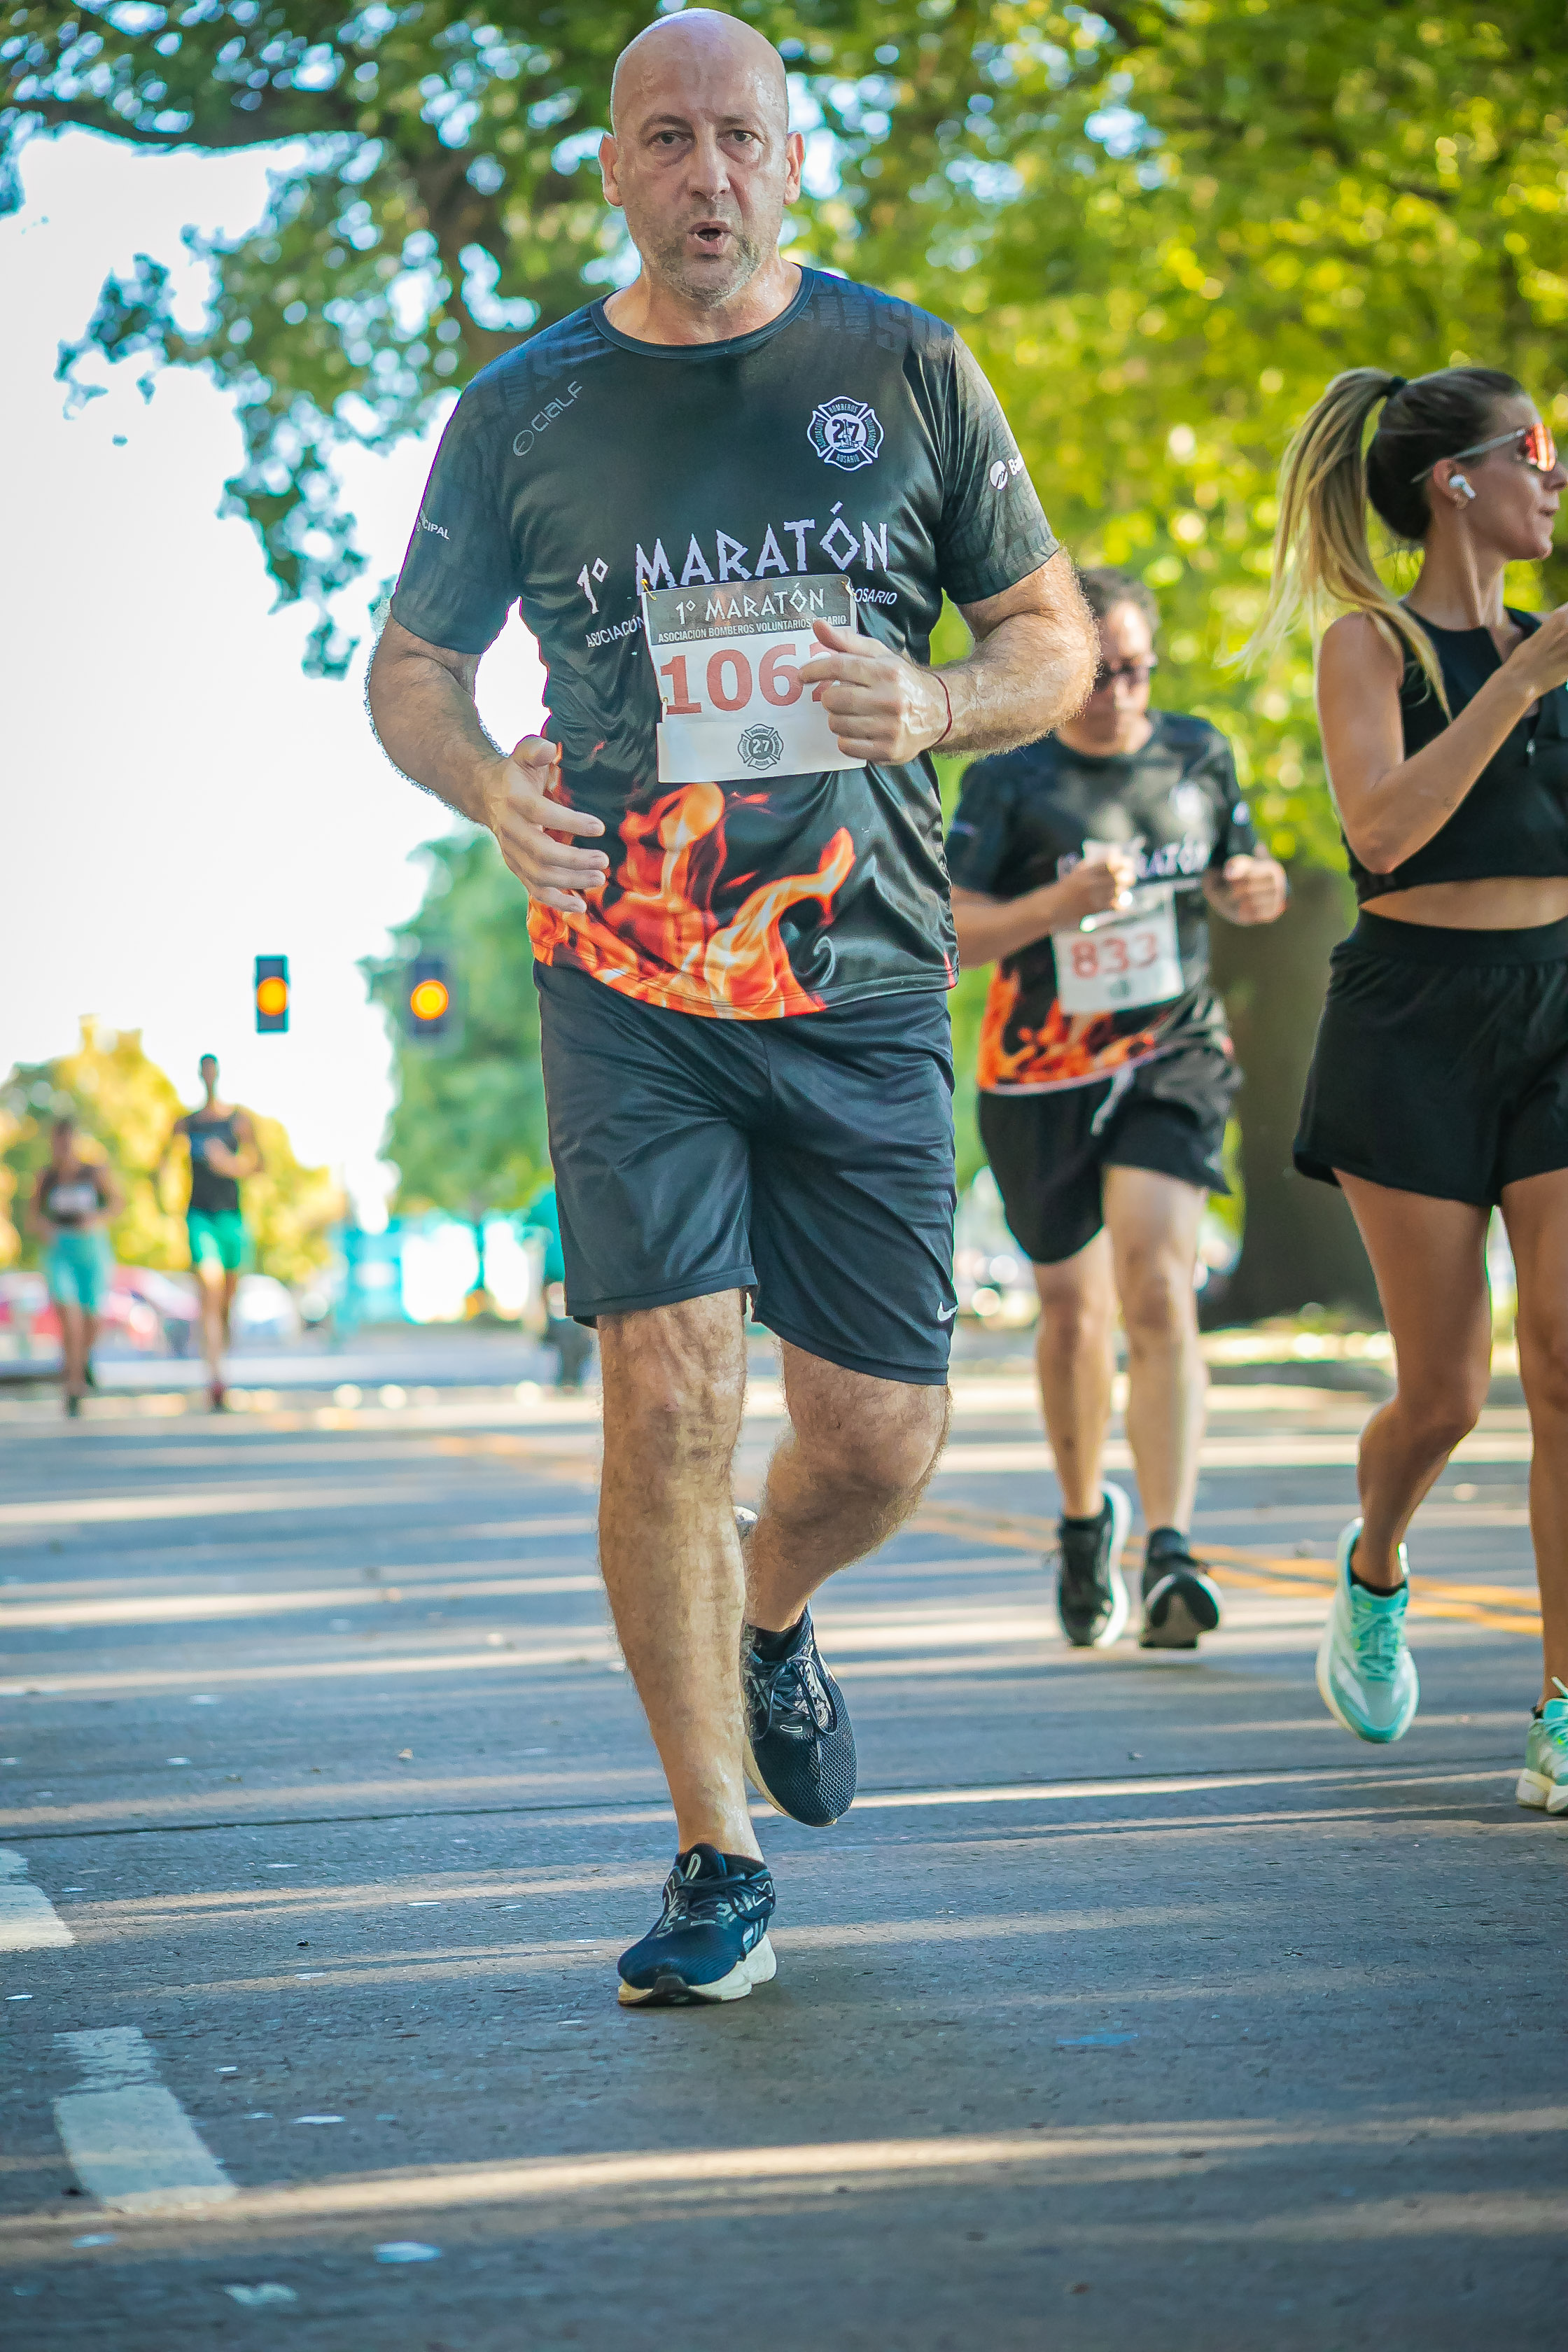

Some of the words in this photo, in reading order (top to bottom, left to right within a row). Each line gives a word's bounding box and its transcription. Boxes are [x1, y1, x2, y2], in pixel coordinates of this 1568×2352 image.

[828, 403, 858, 414] BOMBEROS
[832, 419, 860, 443] 27
[836, 454, 860, 463] ROSARIO
[420, 514, 450, 540] CIPAL
[636, 501, 888, 596] MARATÓN
[704, 582, 825, 621] MARATÓN
[852, 588, 897, 605] OSARIO
[658, 627, 707, 643] ASOCIACIÓN
[708, 624, 755, 637] BOMBEROS
[755, 618, 811, 632] VOLUNTARIOS
[813, 615, 847, 626] ARIO
[752, 738, 770, 754] 27
